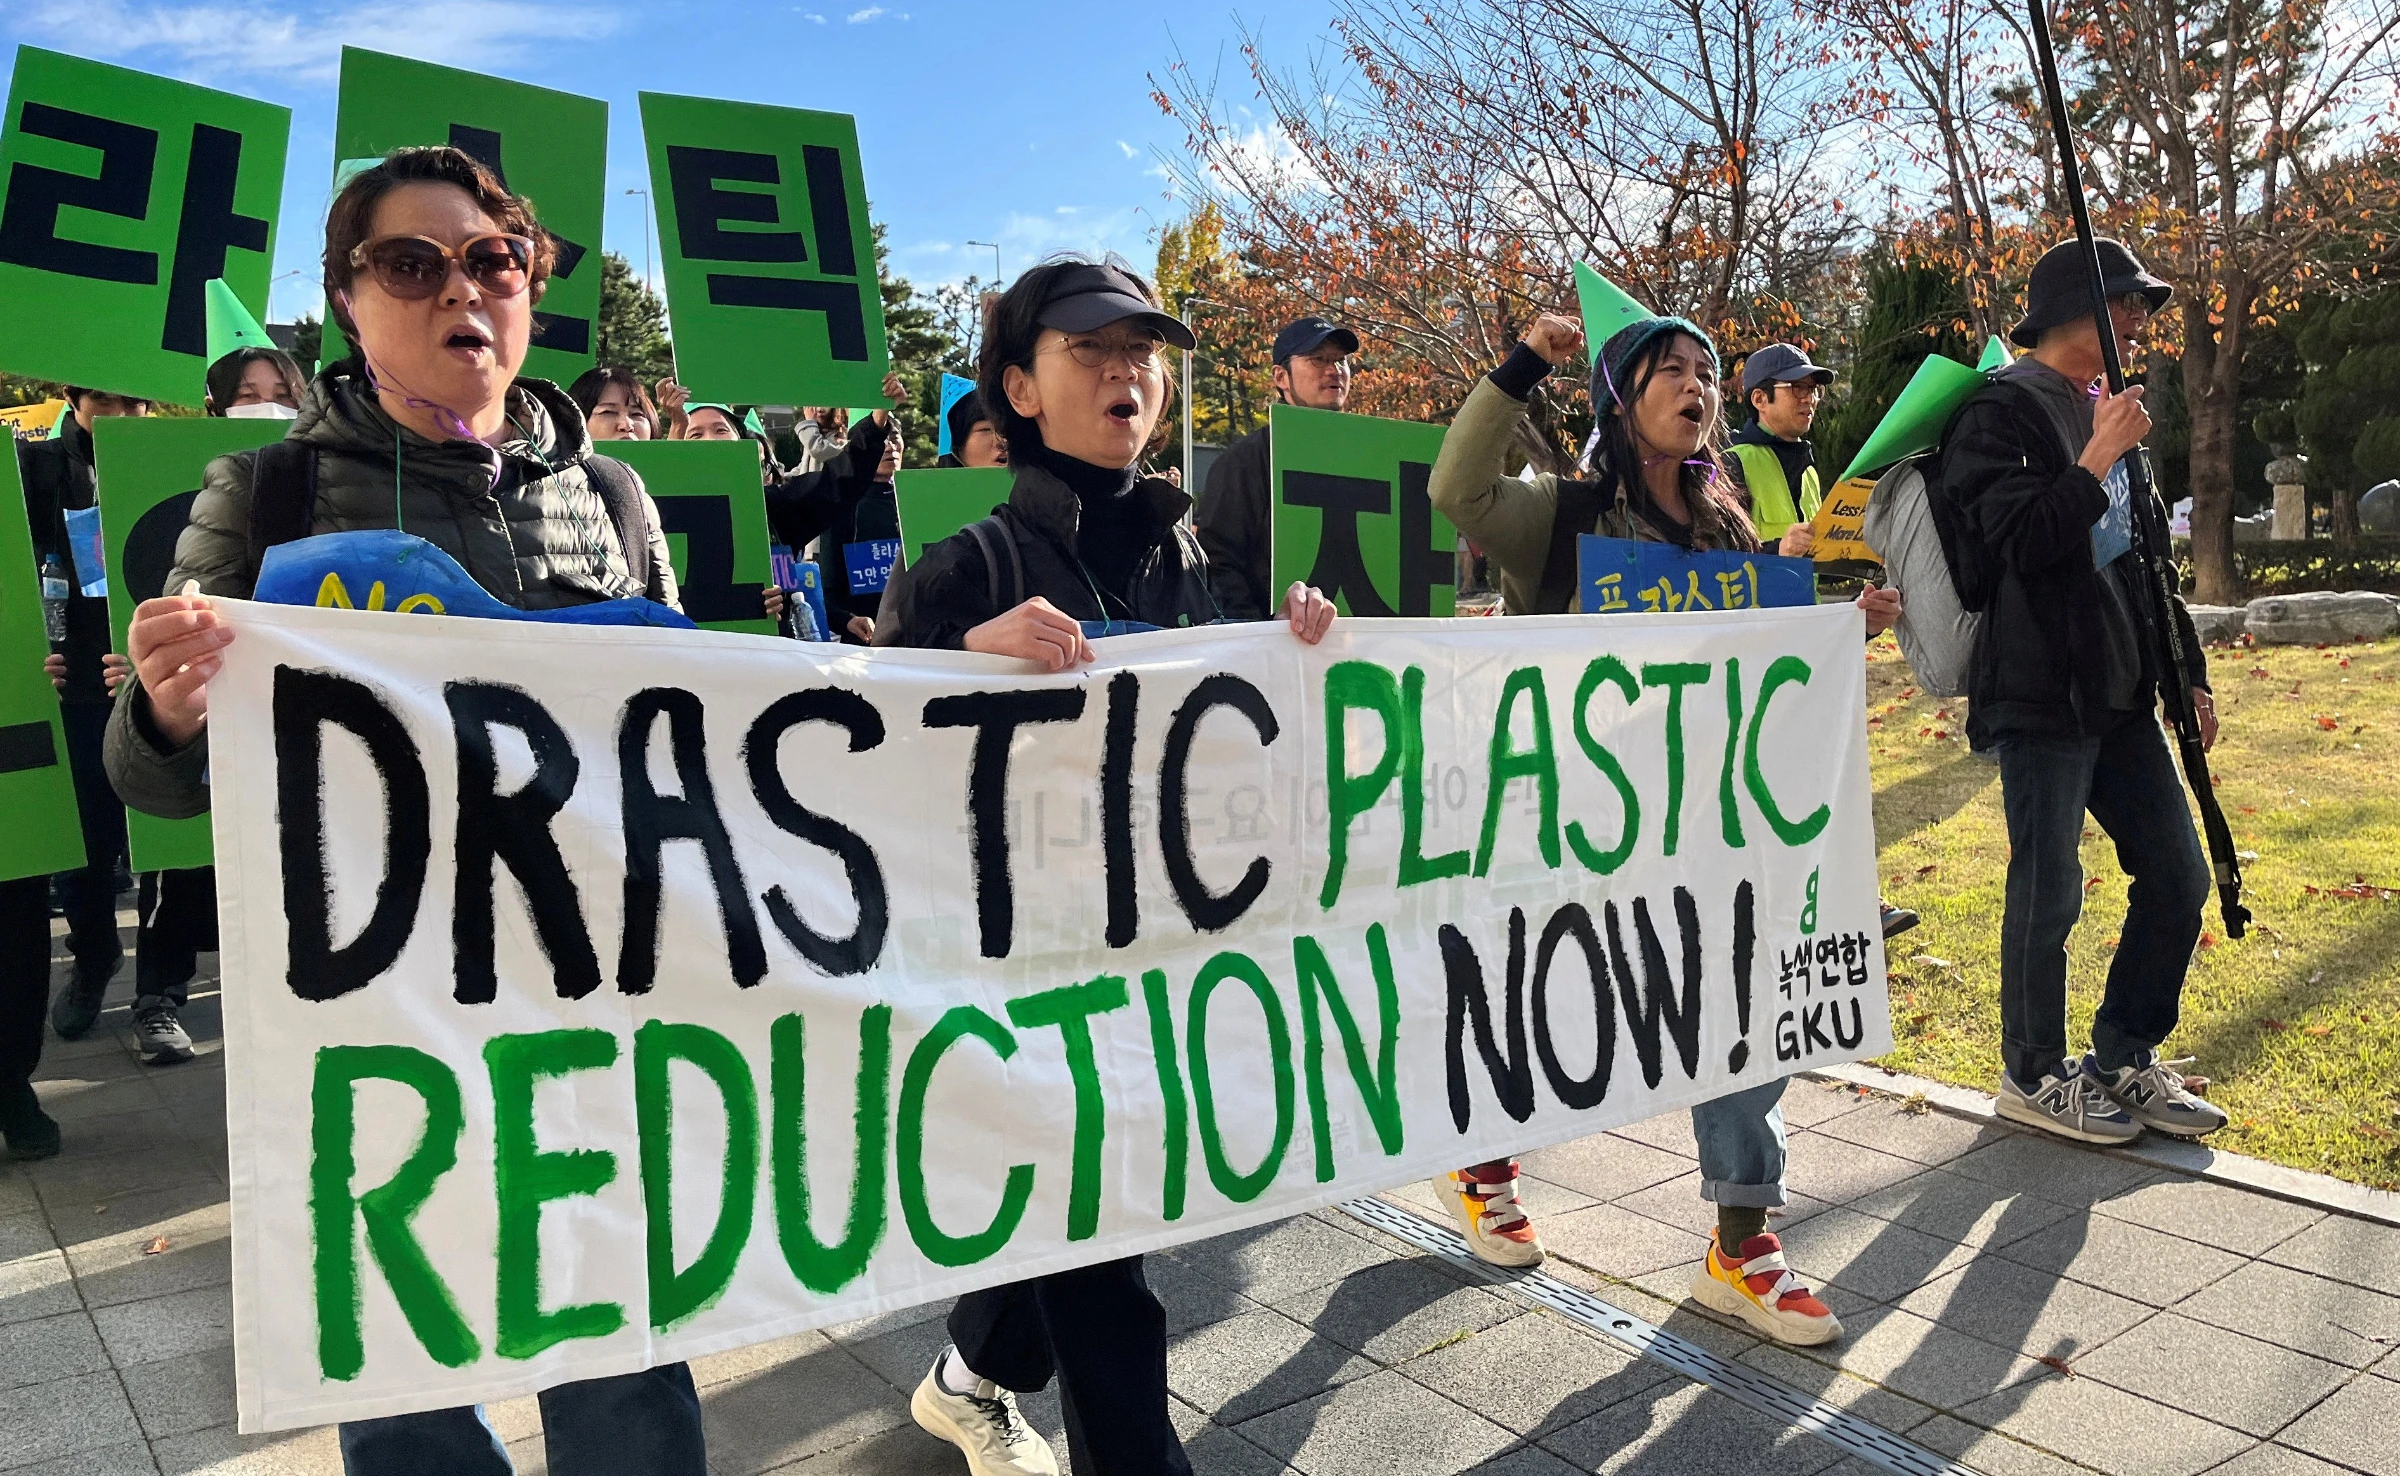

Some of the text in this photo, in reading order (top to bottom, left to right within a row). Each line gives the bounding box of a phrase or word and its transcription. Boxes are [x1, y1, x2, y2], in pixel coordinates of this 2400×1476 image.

[0, 101, 269, 358] 라
[666, 144, 869, 362] 틱
[1824, 524, 1855, 541] More
[1831, 499, 1861, 517] Less
[853, 566, 878, 587] 그만
[273, 653, 1831, 1004] DRASTIC PLASTIC
[1779, 931, 1871, 1000] 녹색연합
[1775, 997, 1864, 1062] GKU
[309, 922, 1403, 1382] REDUCTION
